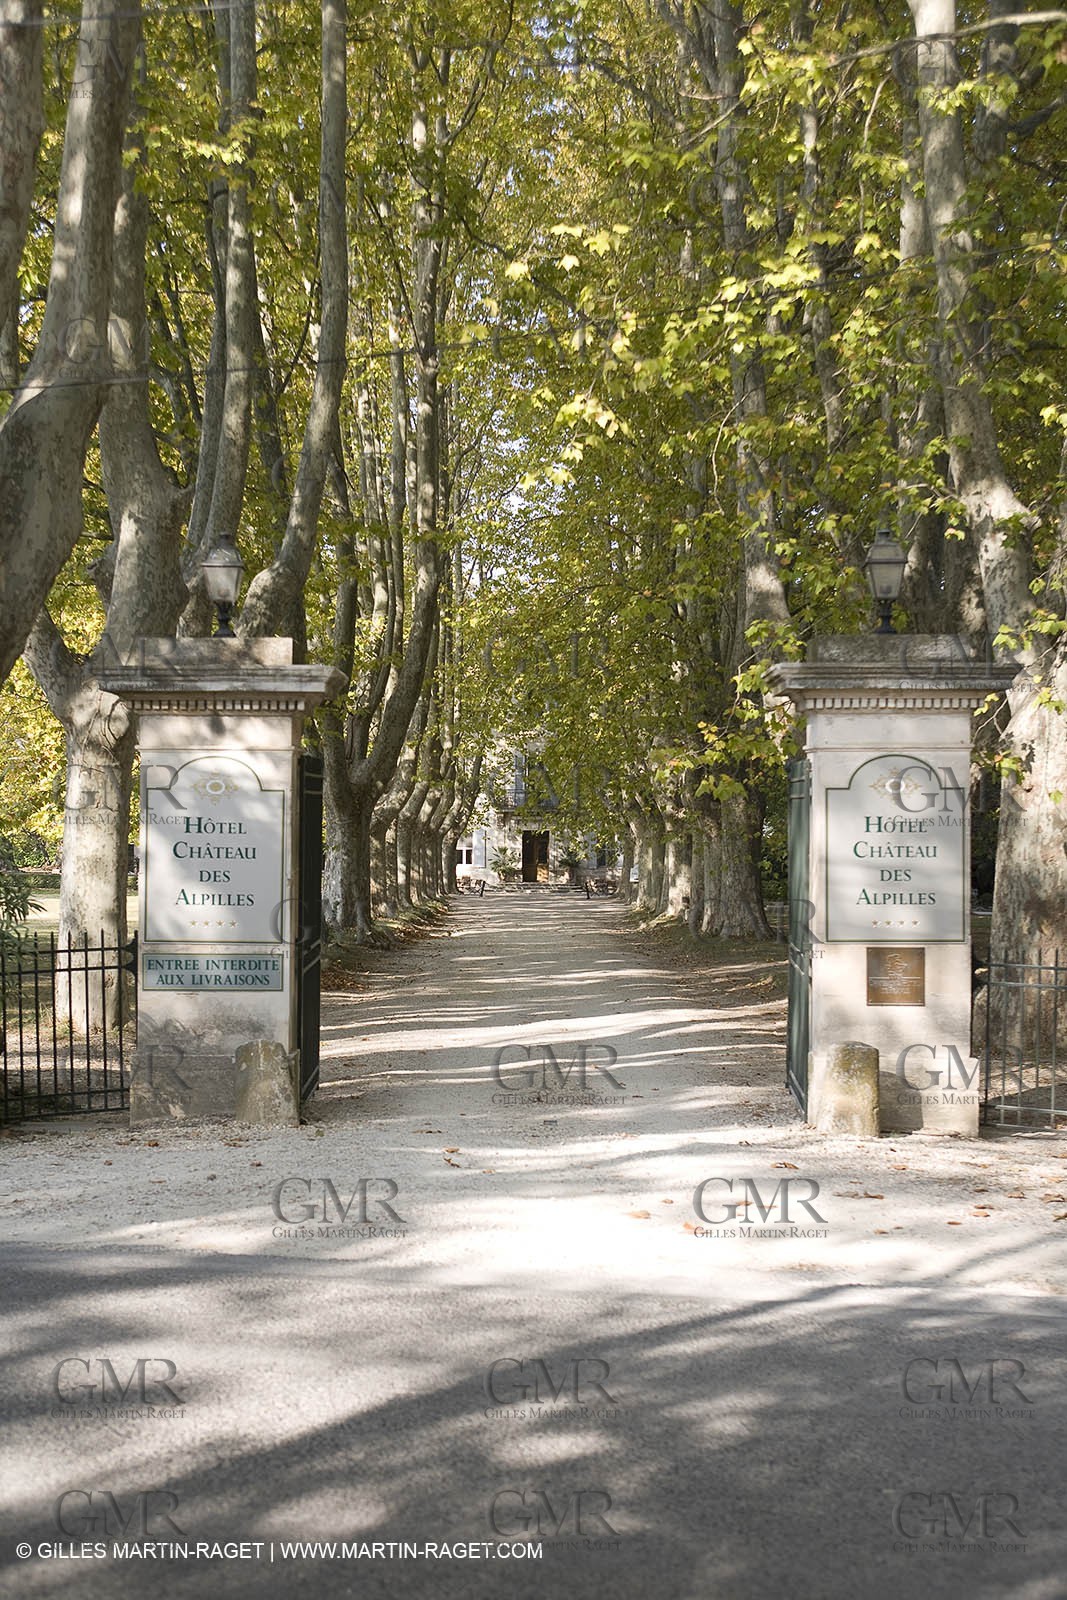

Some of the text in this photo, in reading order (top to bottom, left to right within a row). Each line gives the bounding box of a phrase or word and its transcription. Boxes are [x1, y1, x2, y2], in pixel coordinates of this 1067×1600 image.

[184, 816, 247, 834] HÔTEL
[864, 816, 928, 833] HÔTEL
[172, 841, 257, 859] CHÂTEAU
[853, 840, 937, 858] CHÂTEAU
[199, 870, 231, 883] DES
[879, 869, 912, 881] DES
[175, 889, 255, 906] ALPILLES
[856, 888, 936, 905] ALPILLES
[206, 958, 280, 971] INTERDITE
[156, 974, 271, 985] AUX LIVRAISONS
